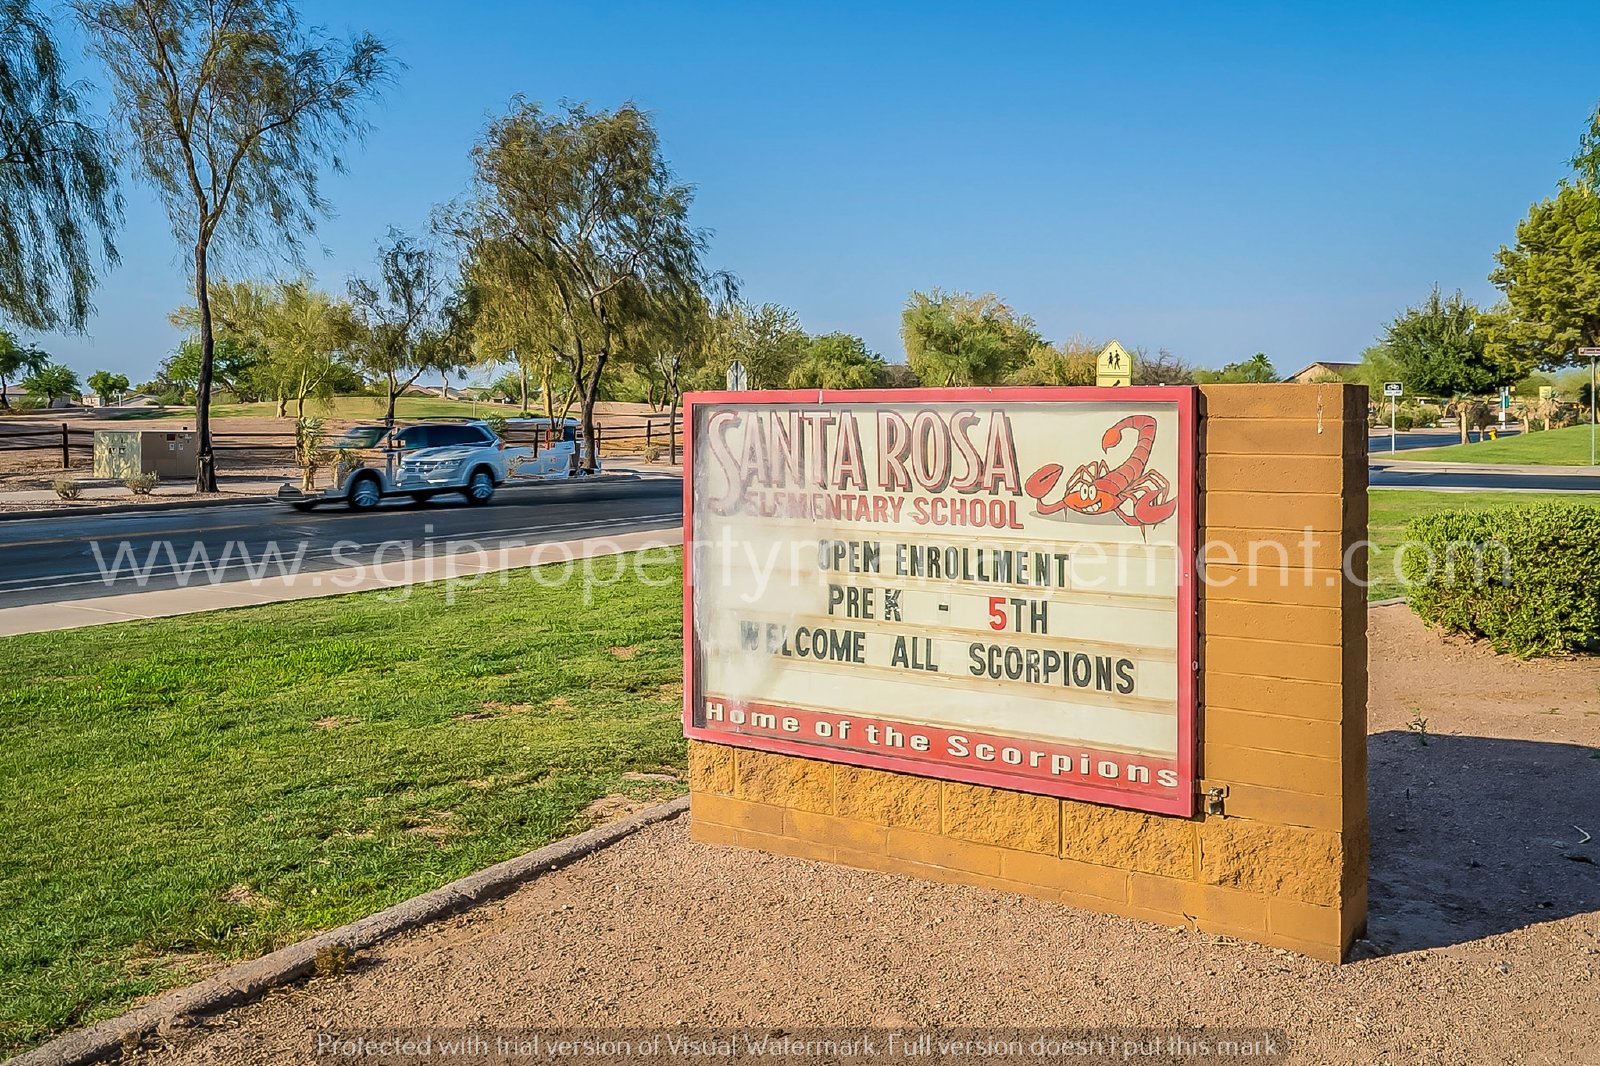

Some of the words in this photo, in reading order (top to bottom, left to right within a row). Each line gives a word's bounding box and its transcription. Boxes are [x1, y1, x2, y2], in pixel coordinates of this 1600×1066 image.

[707, 409, 867, 516] SANTA
[878, 409, 1022, 497] ROSA
[746, 490, 903, 524] ELEMENTARY
[912, 495, 1025, 531] SCHOOL
[817, 539, 881, 574] OPEN
[895, 543, 1069, 588] ENROLLMENT
[988, 596, 1049, 636] 5TH
[740, 620, 866, 664] WELCOME
[891, 635, 938, 673] ALL
[968, 642, 1135, 695] SCORPIONS
[705, 700, 800, 733] Home
[814, 719, 851, 740] of
[864, 724, 931, 753] the
[946, 735, 1179, 788] Scorpions
